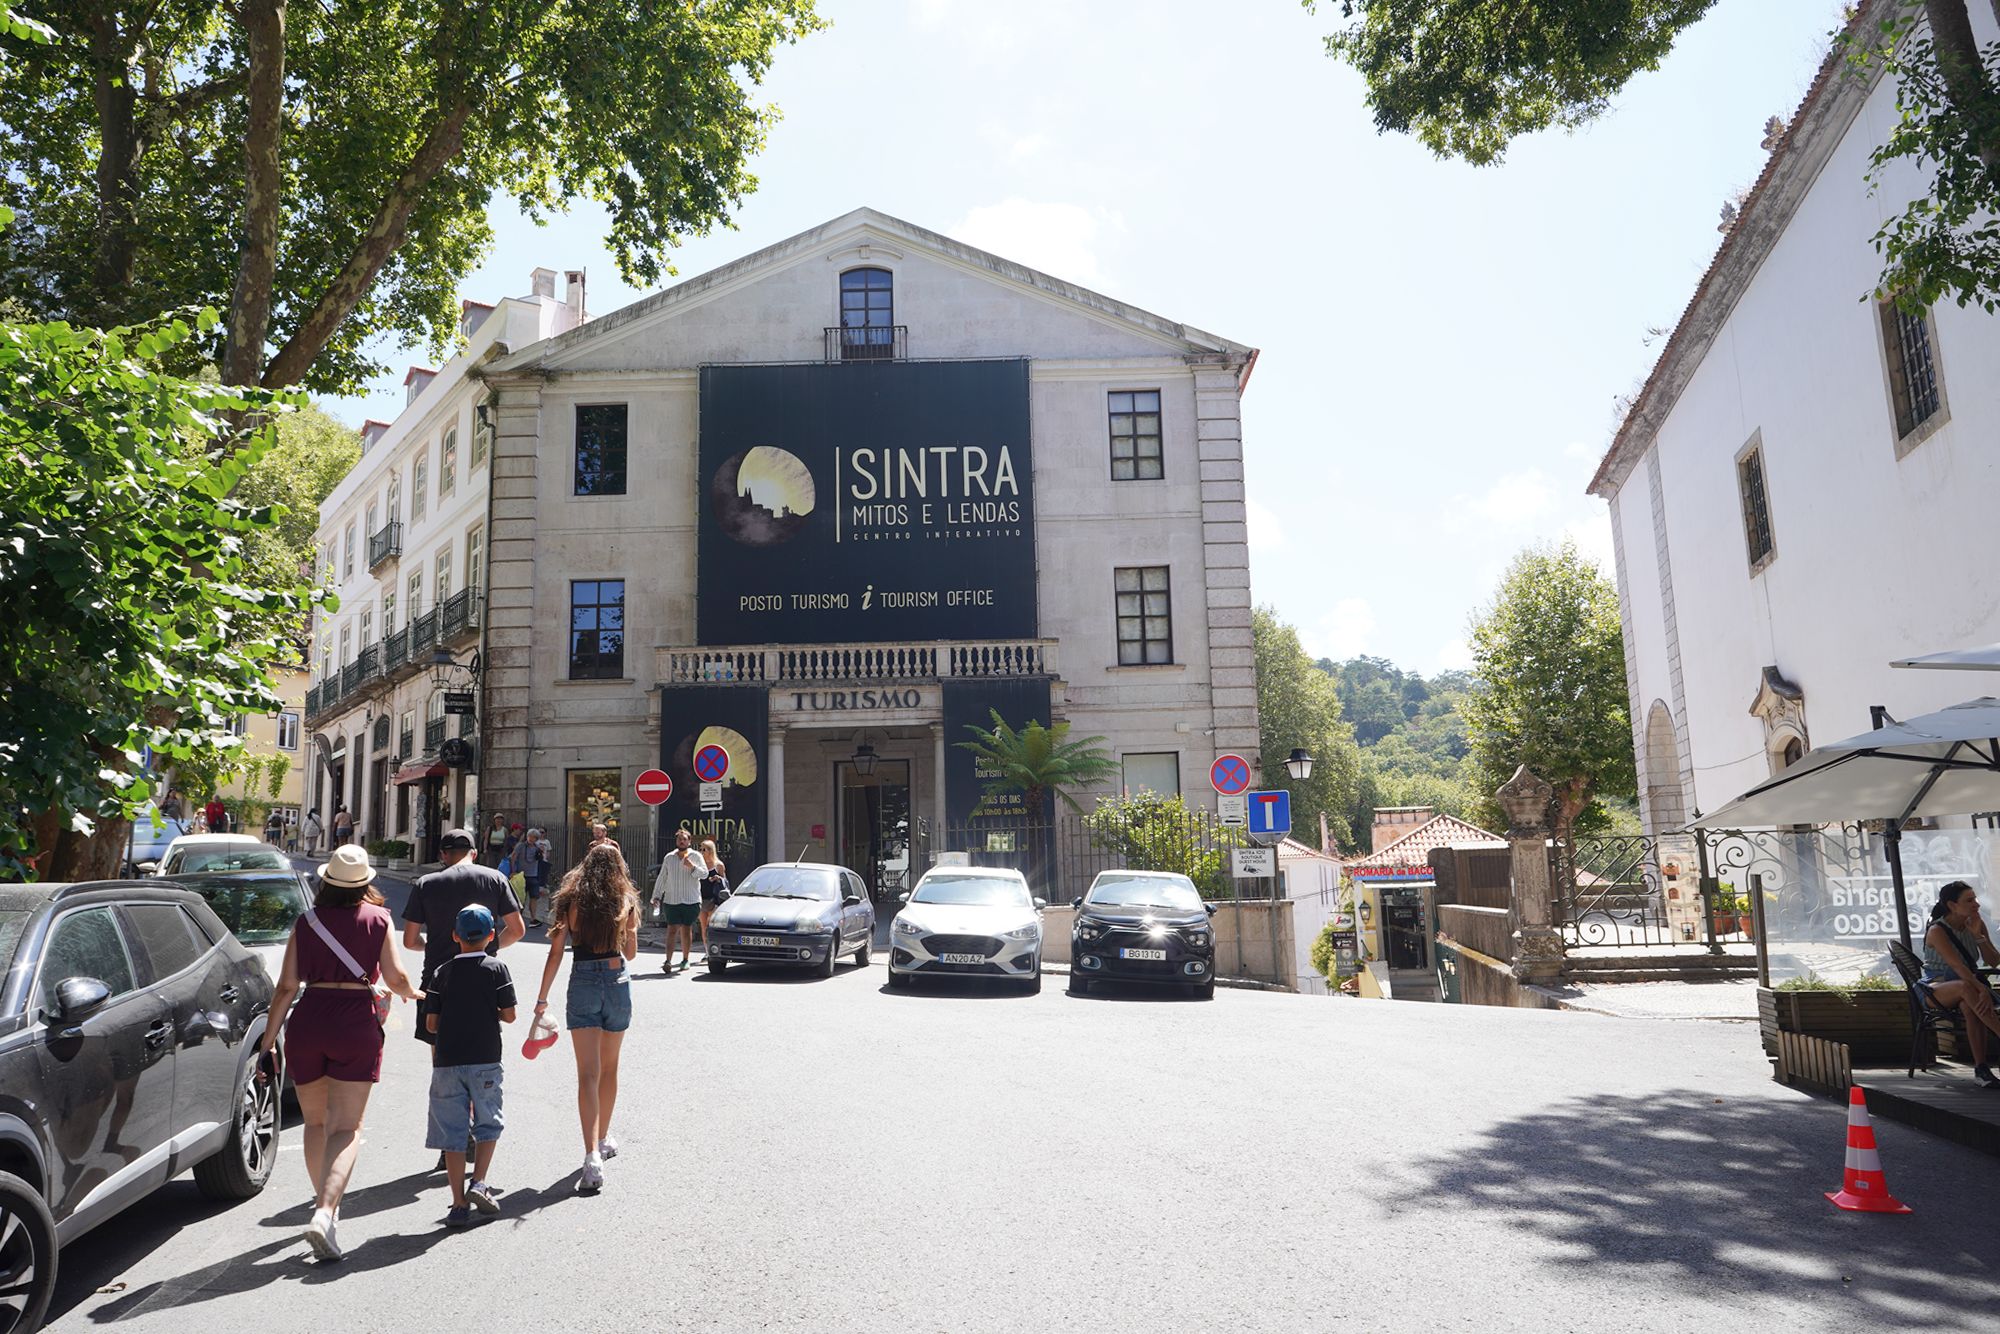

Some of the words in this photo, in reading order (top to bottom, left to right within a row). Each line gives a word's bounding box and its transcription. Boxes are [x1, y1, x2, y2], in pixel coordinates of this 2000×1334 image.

[851, 445, 1019, 500] SINTRA
[853, 504, 909, 526] MITOS
[922, 503, 933, 525] E
[947, 501, 1020, 524] LENDAS
[853, 531, 911, 541] CENTRO
[926, 529, 1021, 539] INTERATIVO
[740, 595, 782, 611] POSTO
[791, 593, 849, 609] TURISMO
[880, 592, 938, 608] TOURISM
[946, 589, 994, 607] OFFICE
[791, 688, 921, 711] TURISMO
[974, 768, 1002, 778] Tourism
[680, 818, 748, 841] SINTRA
[1353, 867, 1395, 877] ROMARIA
[1407, 866, 1434, 875] BACO
